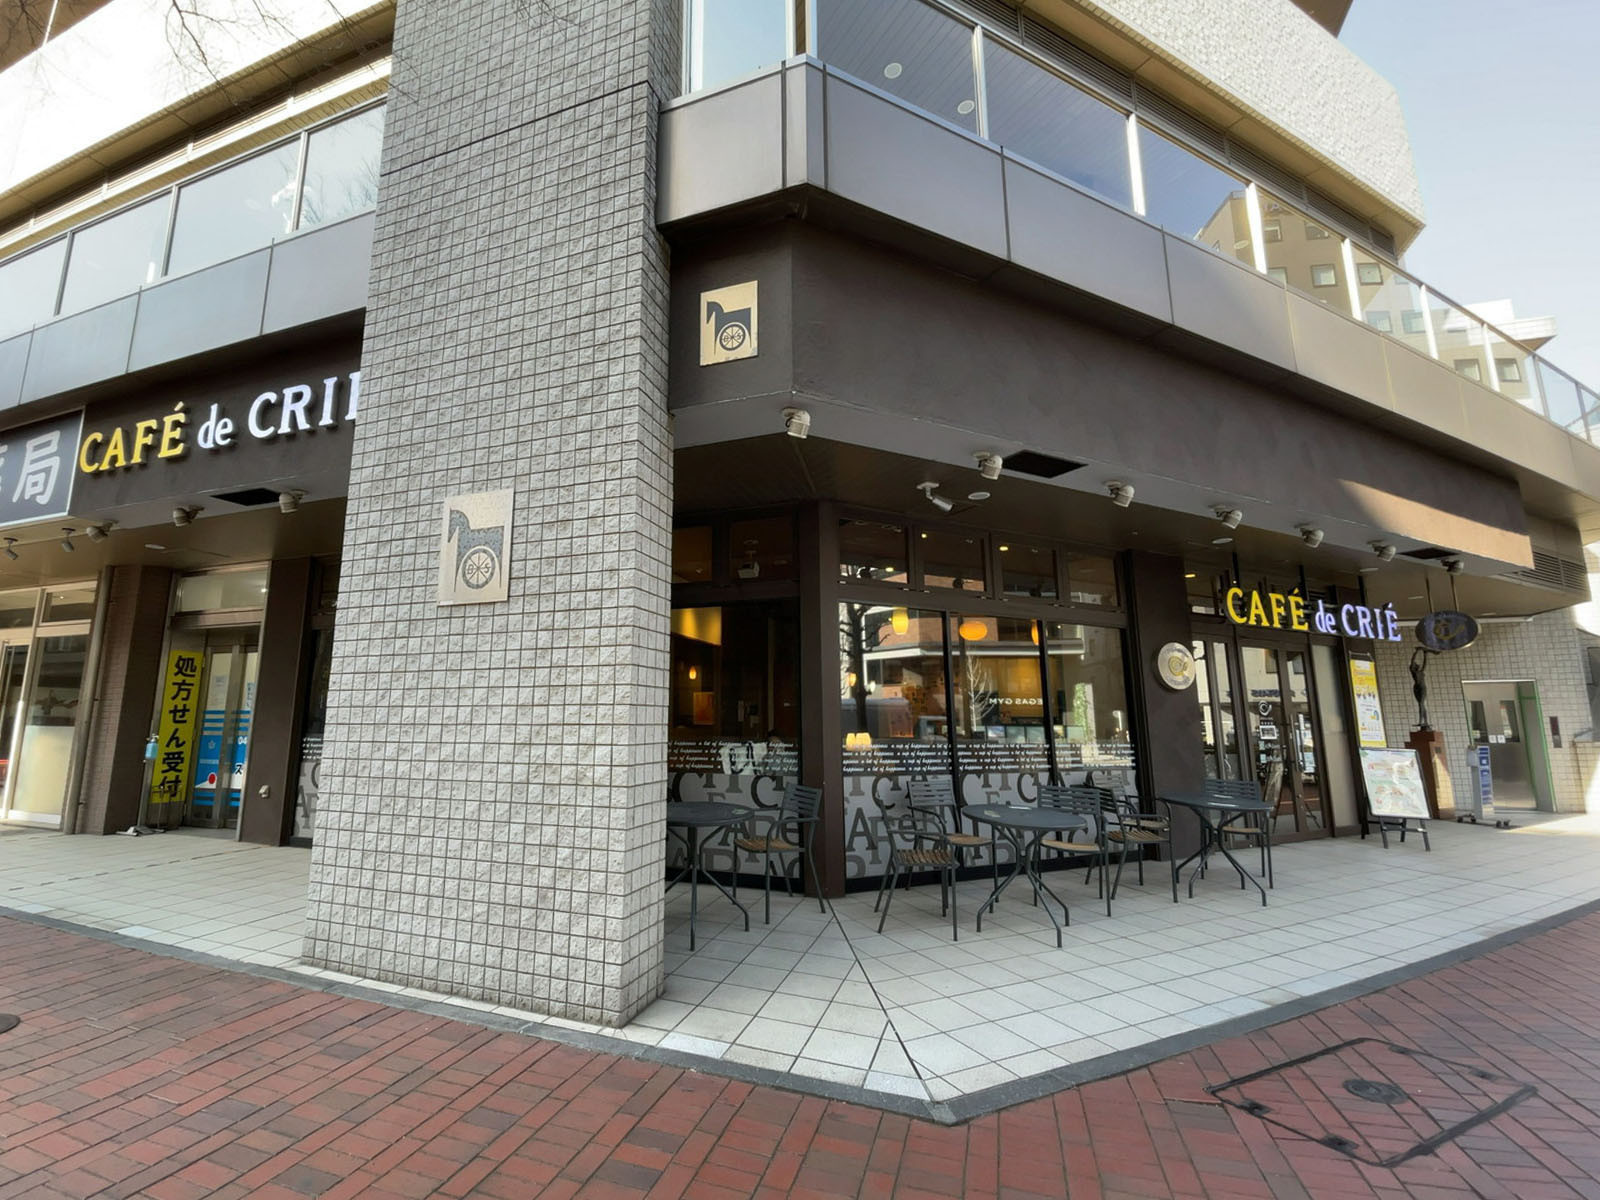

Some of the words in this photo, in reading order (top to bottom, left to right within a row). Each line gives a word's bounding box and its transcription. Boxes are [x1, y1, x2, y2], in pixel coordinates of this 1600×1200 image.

[0, 430, 61, 505] 局
[80, 401, 187, 473] CAFÉ
[198, 403, 234, 449] de
[1226, 587, 1308, 631] CAFÉ
[1315, 600, 1336, 634] de
[1341, 602, 1401, 641] CRIÉ
[160, 655, 197, 798] 処方せん受付
